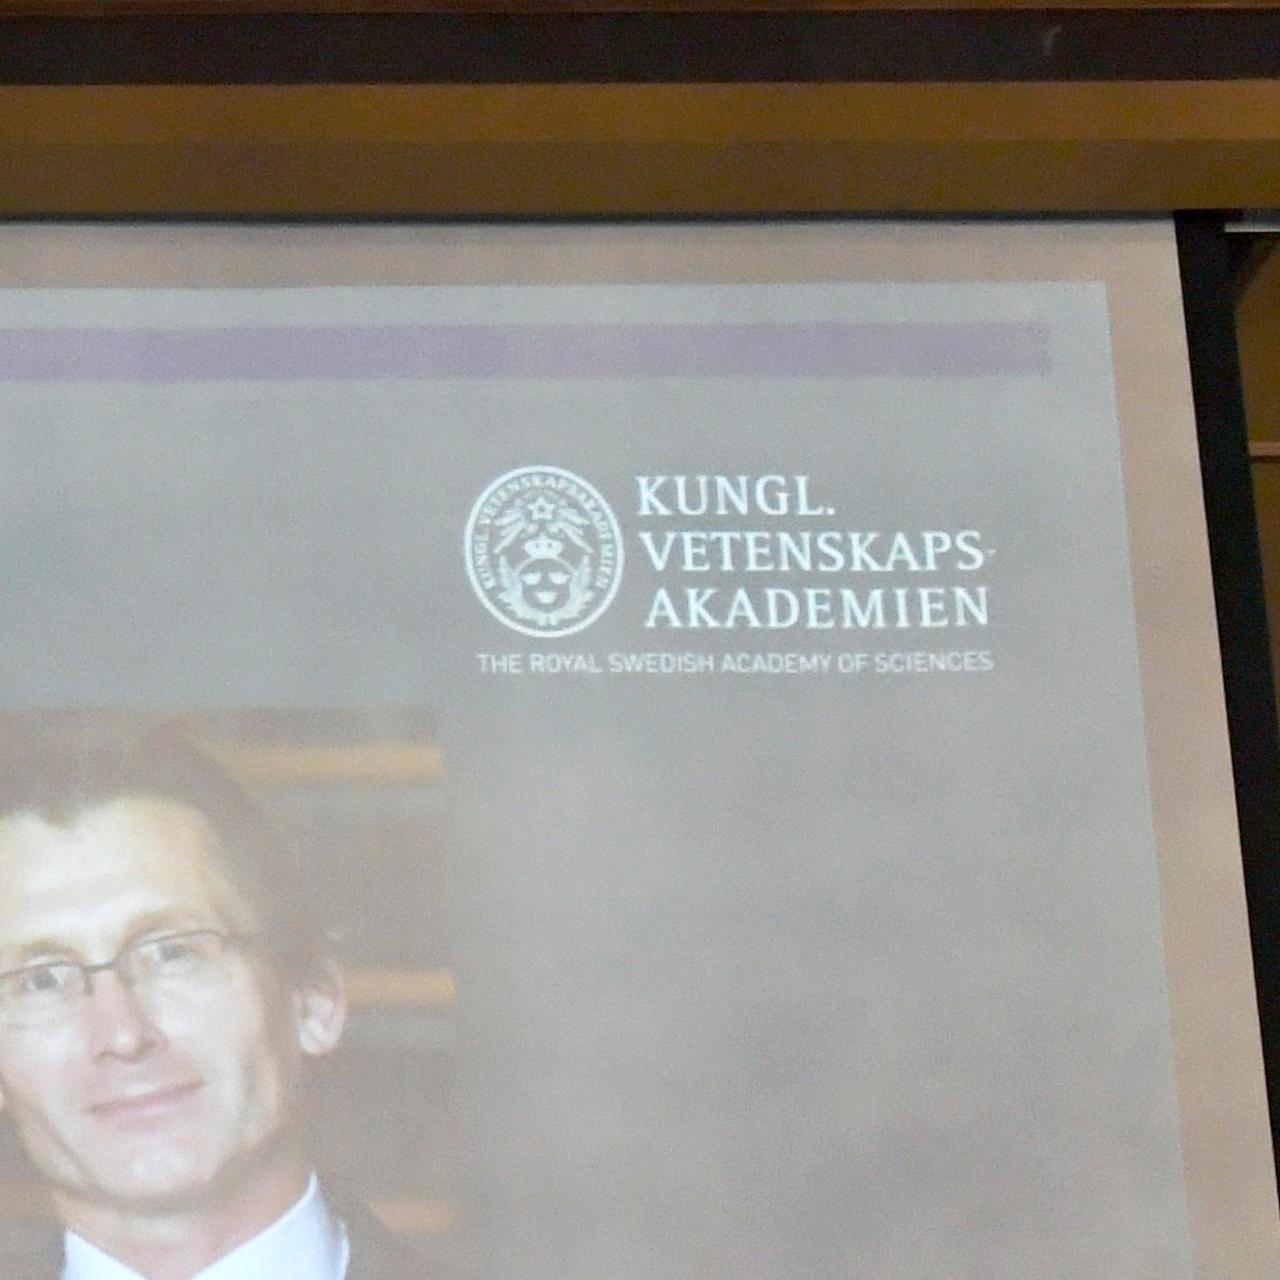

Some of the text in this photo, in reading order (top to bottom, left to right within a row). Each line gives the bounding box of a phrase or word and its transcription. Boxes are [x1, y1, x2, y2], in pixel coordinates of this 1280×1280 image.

[636, 474, 835, 516] KUNGL.
[645, 586, 988, 629] AKADEMIEN
[477, 650, 994, 674] THE ROYAL SWEDISH ACADEMY OF SCIENCES
